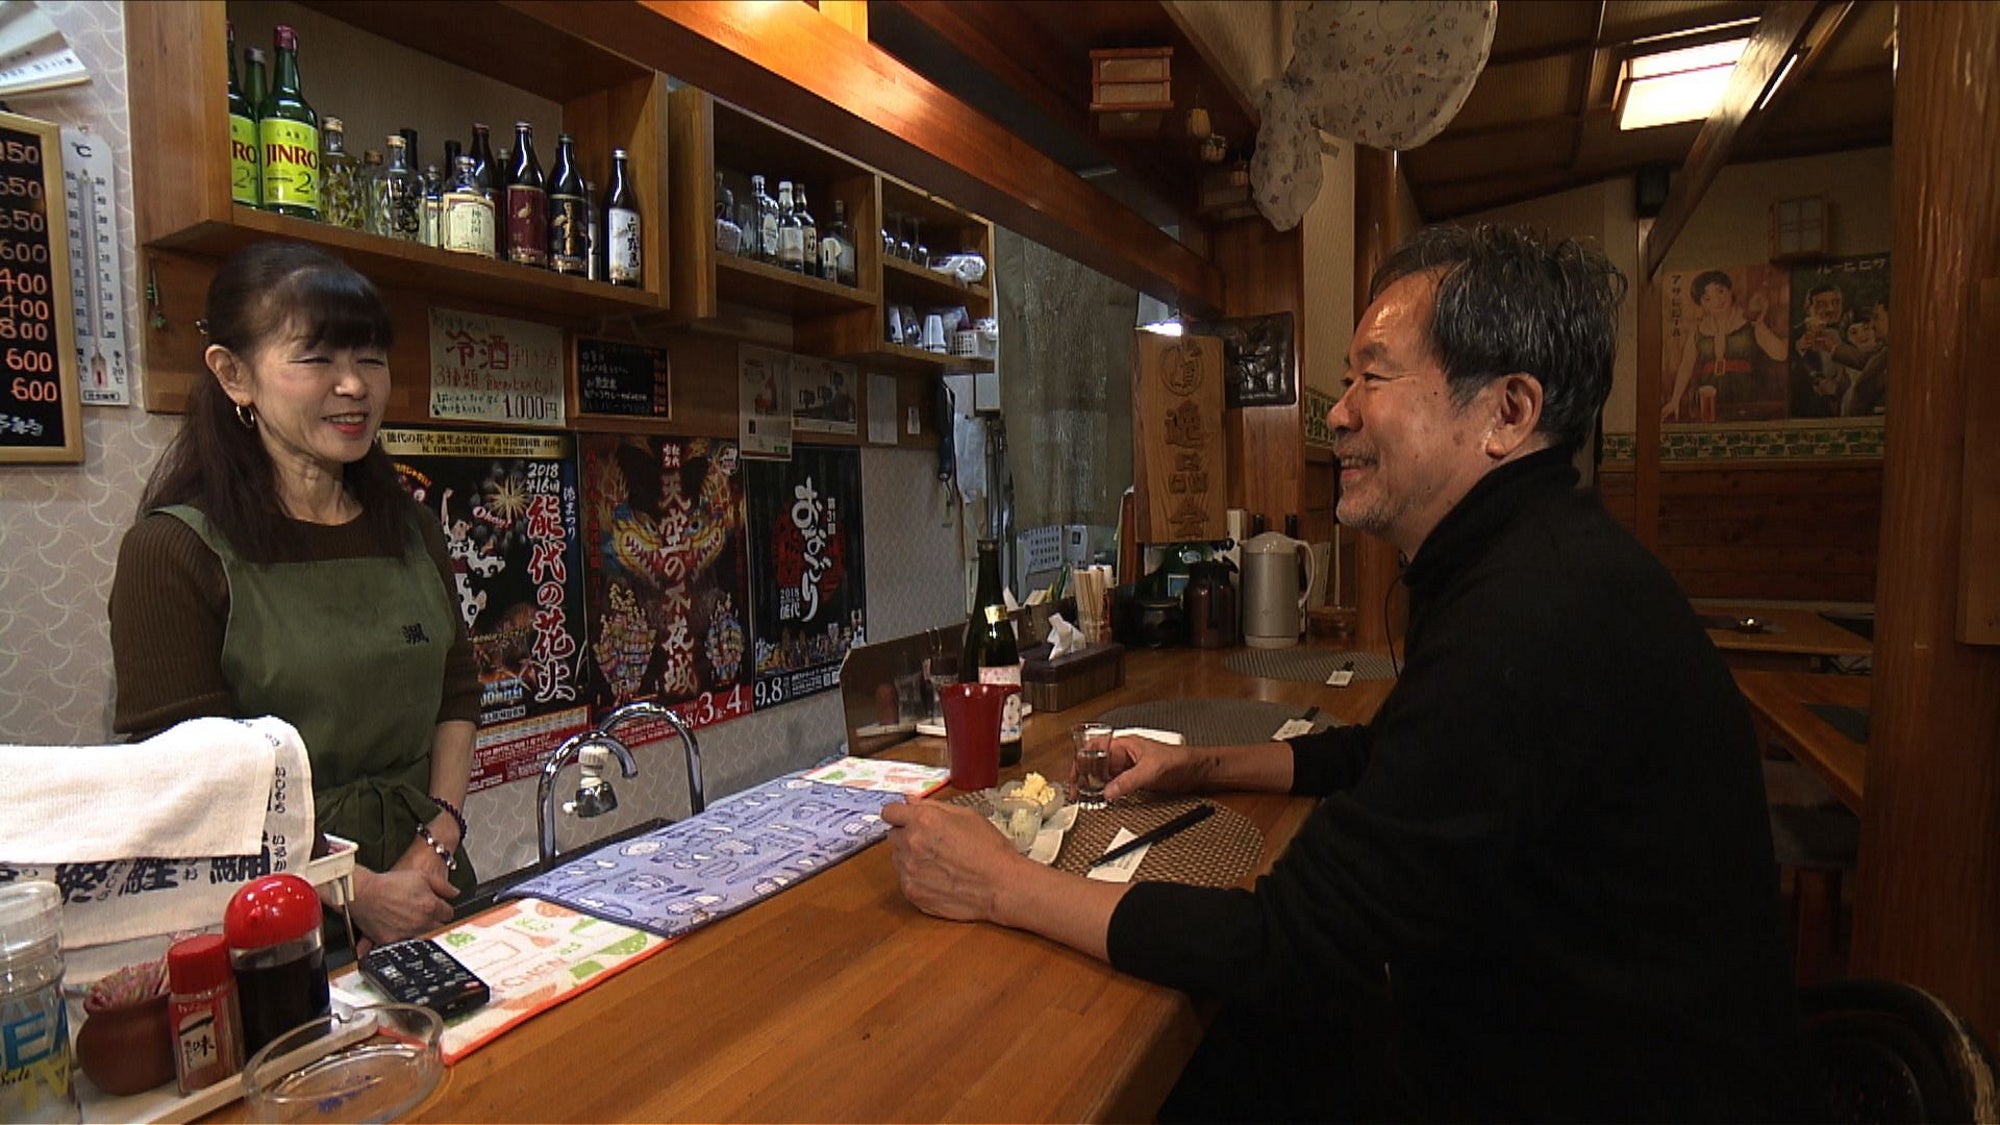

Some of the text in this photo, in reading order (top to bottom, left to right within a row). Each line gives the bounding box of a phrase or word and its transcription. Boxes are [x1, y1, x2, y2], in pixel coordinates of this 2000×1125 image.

[266, 143, 318, 169] JINRO
[6, 347, 53, 373] 600
[445, 331, 510, 370] 冷酒
[10, 377, 58, 403] 600
[504, 394, 558, 420] 1000円
[527, 461, 560, 480] 2018
[526, 493, 579, 703] 能代の花火
